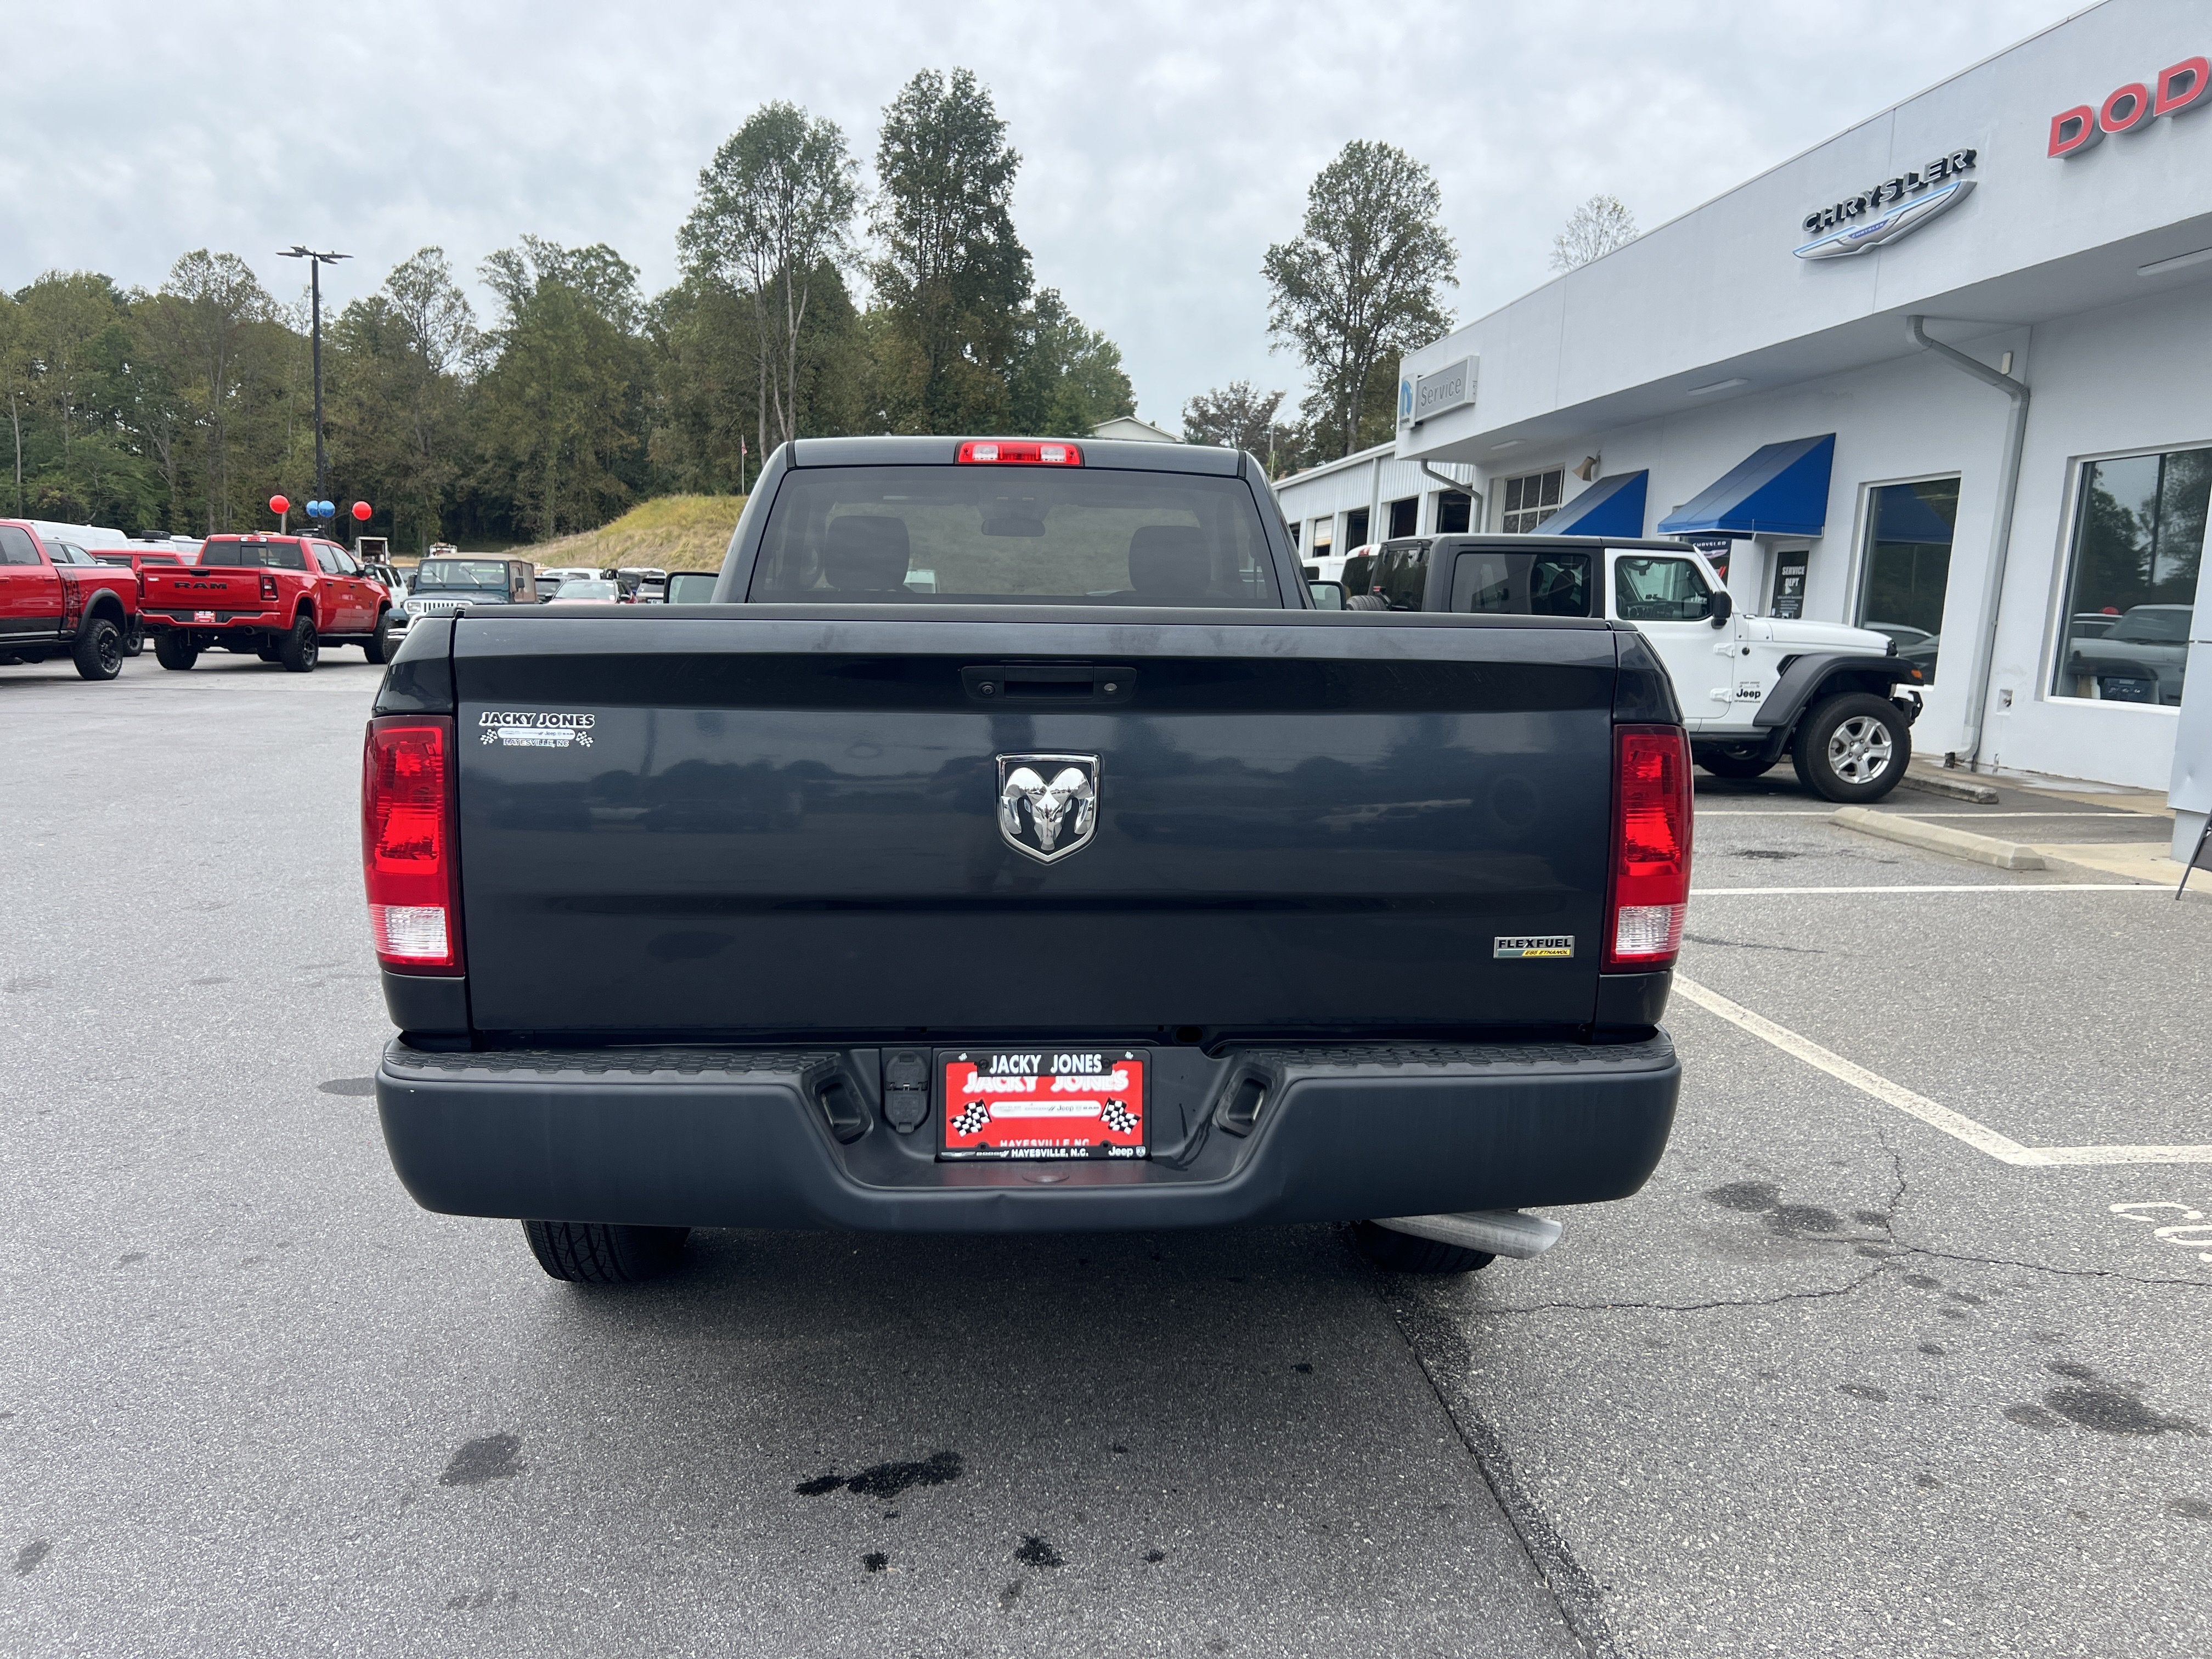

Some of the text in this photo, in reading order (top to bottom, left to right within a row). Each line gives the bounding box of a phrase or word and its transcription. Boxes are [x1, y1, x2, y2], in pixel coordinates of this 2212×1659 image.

[1802, 148, 1971, 233] CHRYSLER
[1420, 377, 1462, 407] Service
[1782, 566, 1805, 575] SERVICE
[1785, 577, 1799, 587] DEPT
[1736, 689, 1761, 699] Jeep
[479, 712, 595, 729] JACKY JONES
[1498, 939, 1571, 948] FLEXFUEL
[990, 1053, 1102, 1075] JACKY JONES
[963, 1069, 1130, 1093] JACKY JONES
[1011, 1148, 1069, 1158] HAYESVILLE,
[1070, 1148, 1089, 1157] N.C.
[1108, 1146, 1133, 1158] Jeep
